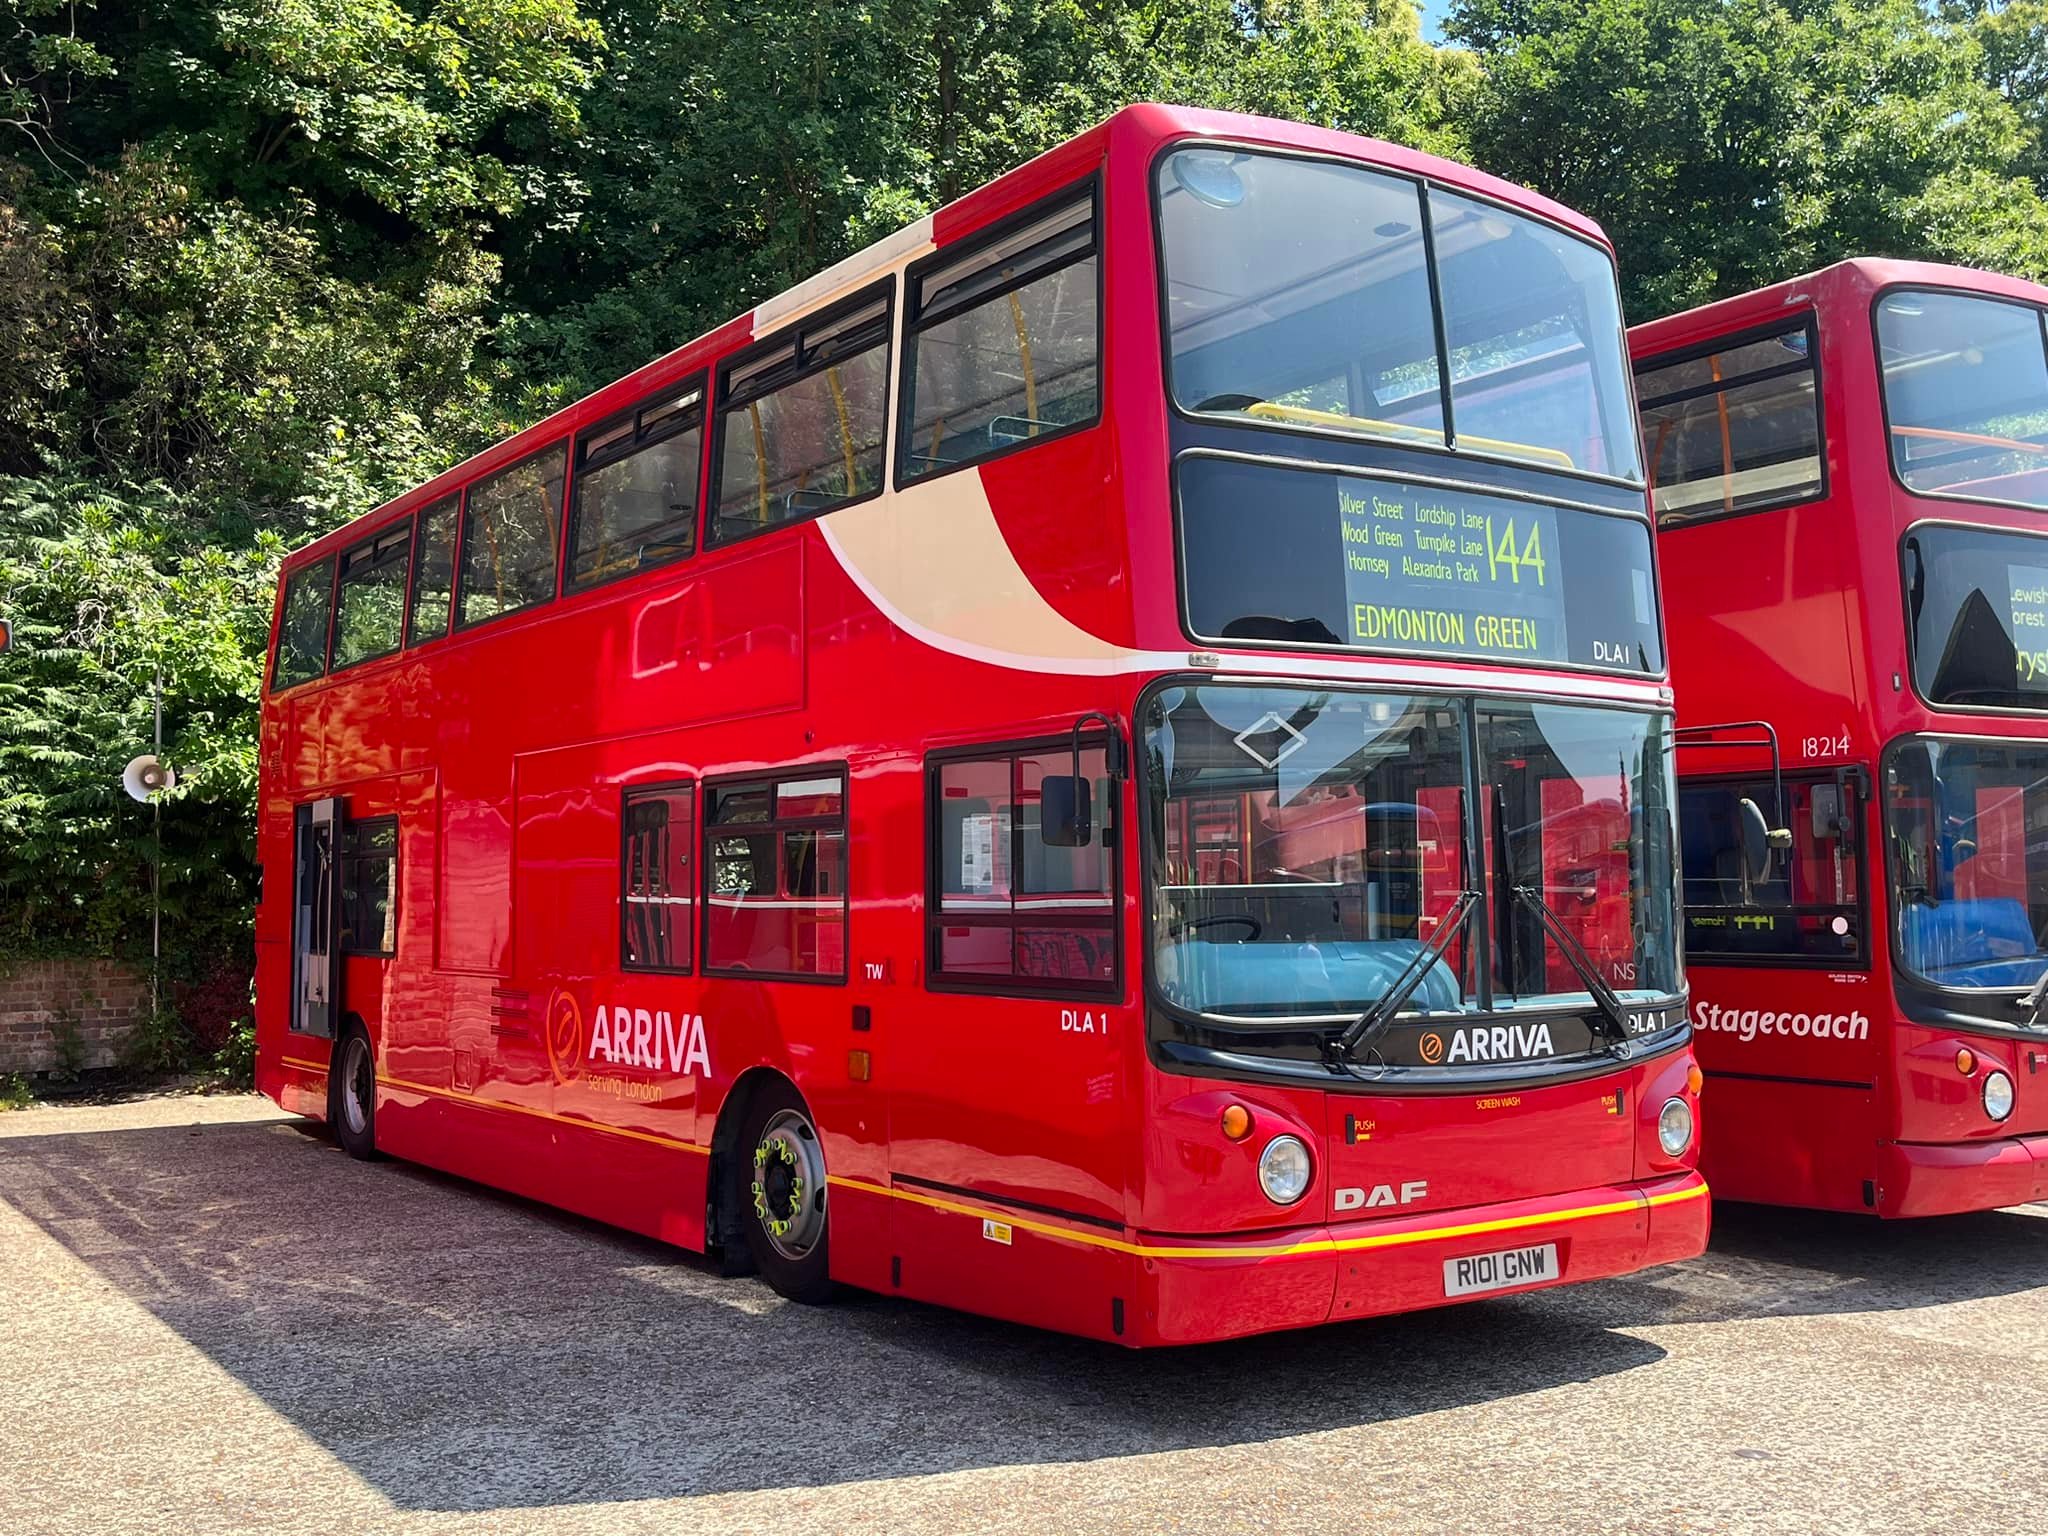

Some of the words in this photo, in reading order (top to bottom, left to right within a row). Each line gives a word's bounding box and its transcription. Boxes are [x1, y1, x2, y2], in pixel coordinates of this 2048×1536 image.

[1339, 491, 1366, 516] Silver
[1372, 496, 1404, 520] Street
[1415, 502, 1456, 530] Lordship
[1461, 508, 1484, 532] Lane
[1342, 521, 1369, 545] Wood
[1375, 525, 1403, 548] Green
[1414, 530, 1456, 557] Turnpike
[1461, 536, 1484, 557] Lane
[1485, 515, 1546, 586] 144
[1348, 551, 1389, 579] Hornsey
[1402, 556, 1452, 580] Alexandra
[1456, 562, 1480, 583] Park
[2010, 586, 2048, 604] ewish
[1354, 604, 1465, 645] EDMONTON
[1474, 615, 1537, 650] GREEN
[2012, 610, 2045, 627] orest
[2014, 643, 2048, 681] rys
[1802, 736, 1850, 758] 18214
[865, 963, 884, 979] TW
[1613, 963, 1636, 981] NS
[1061, 1010, 1095, 1033] DLA
[1100, 1013, 1107, 1034] 1
[1628, 1012, 1657, 1034] DLA
[1660, 1010, 1667, 1030] 1
[1693, 1001, 1869, 1042] Stagecoach
[588, 1005, 712, 1078] ARRIVA
[1447, 1023, 1554, 1063] ARRIVA
[588, 1074, 621, 1101] serving
[625, 1076, 662, 1102] London
[1601, 1095, 1617, 1106] PUSH
[1476, 1098, 1500, 1110] SCREEN
[1500, 1096, 1521, 1108] WASH
[1355, 1120, 1375, 1131] PUSH
[1334, 1180, 1428, 1211] DAF
[1456, 1256, 1498, 1287] R101
[1503, 1247, 1545, 1279] GNW
